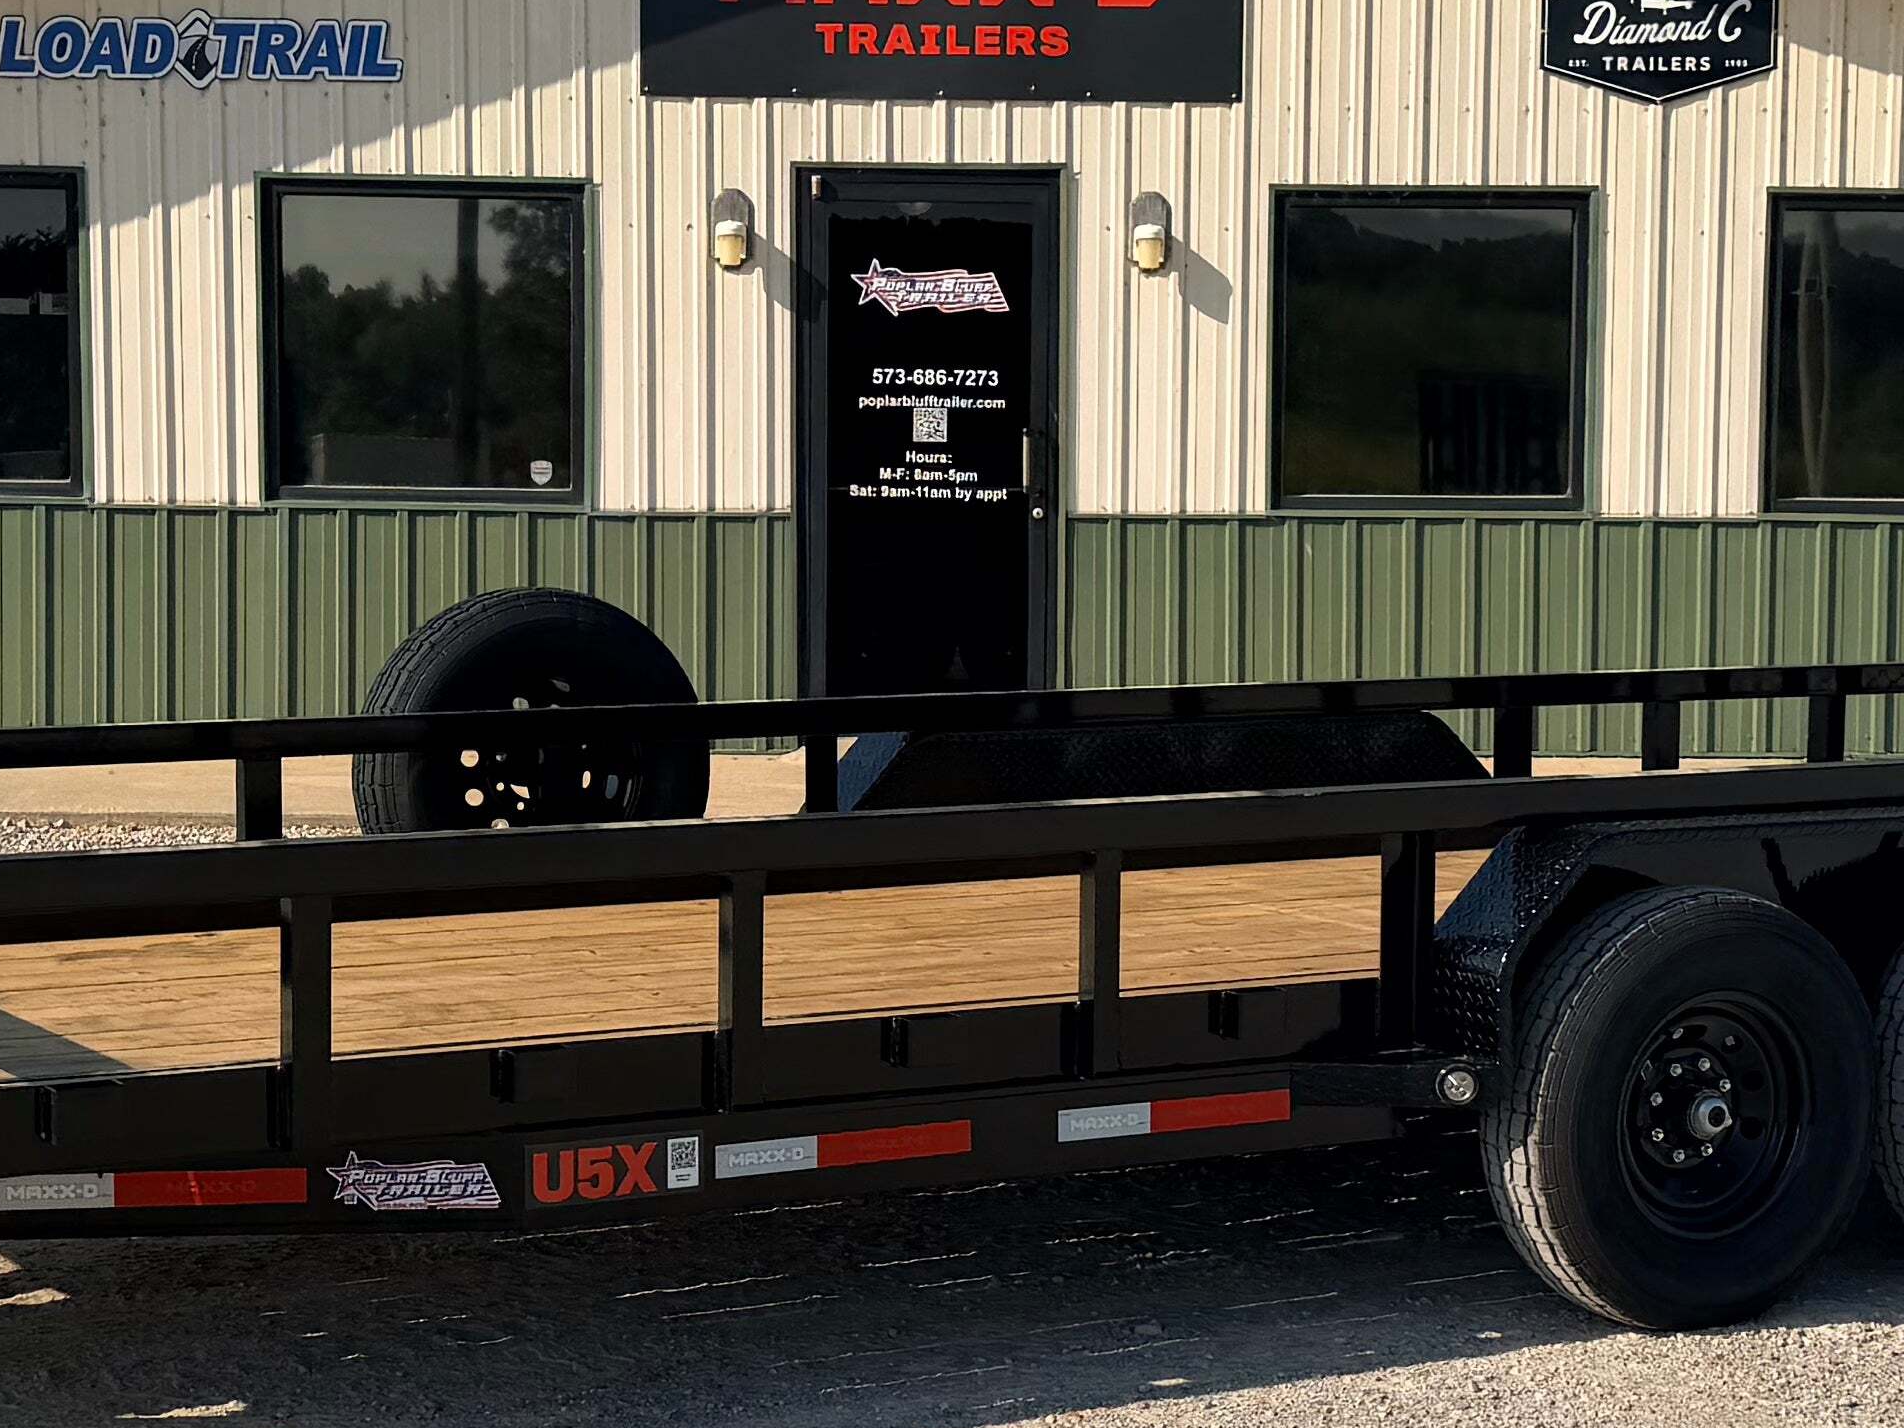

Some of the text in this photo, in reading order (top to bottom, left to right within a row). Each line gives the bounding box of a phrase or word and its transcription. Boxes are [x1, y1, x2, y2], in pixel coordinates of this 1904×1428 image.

[1573, 0, 1719, 45] Diamond
[815, 23, 1069, 56] TRAILERS
[211, 19, 404, 82] TRAIL
[1602, 56, 1712, 71] TRAILERS
[872, 368, 999, 387] 573-686-7273
[858, 395, 1006, 409] poplarblufftrailer.com
[849, 484, 877, 497] Sat:
[955, 487, 973, 502] by
[975, 489, 1008, 502] appt
[728, 1147, 805, 1168] MAXX-D
[532, 1142, 658, 1204] U5X
[6, 1184, 98, 1200] MAXX-D
